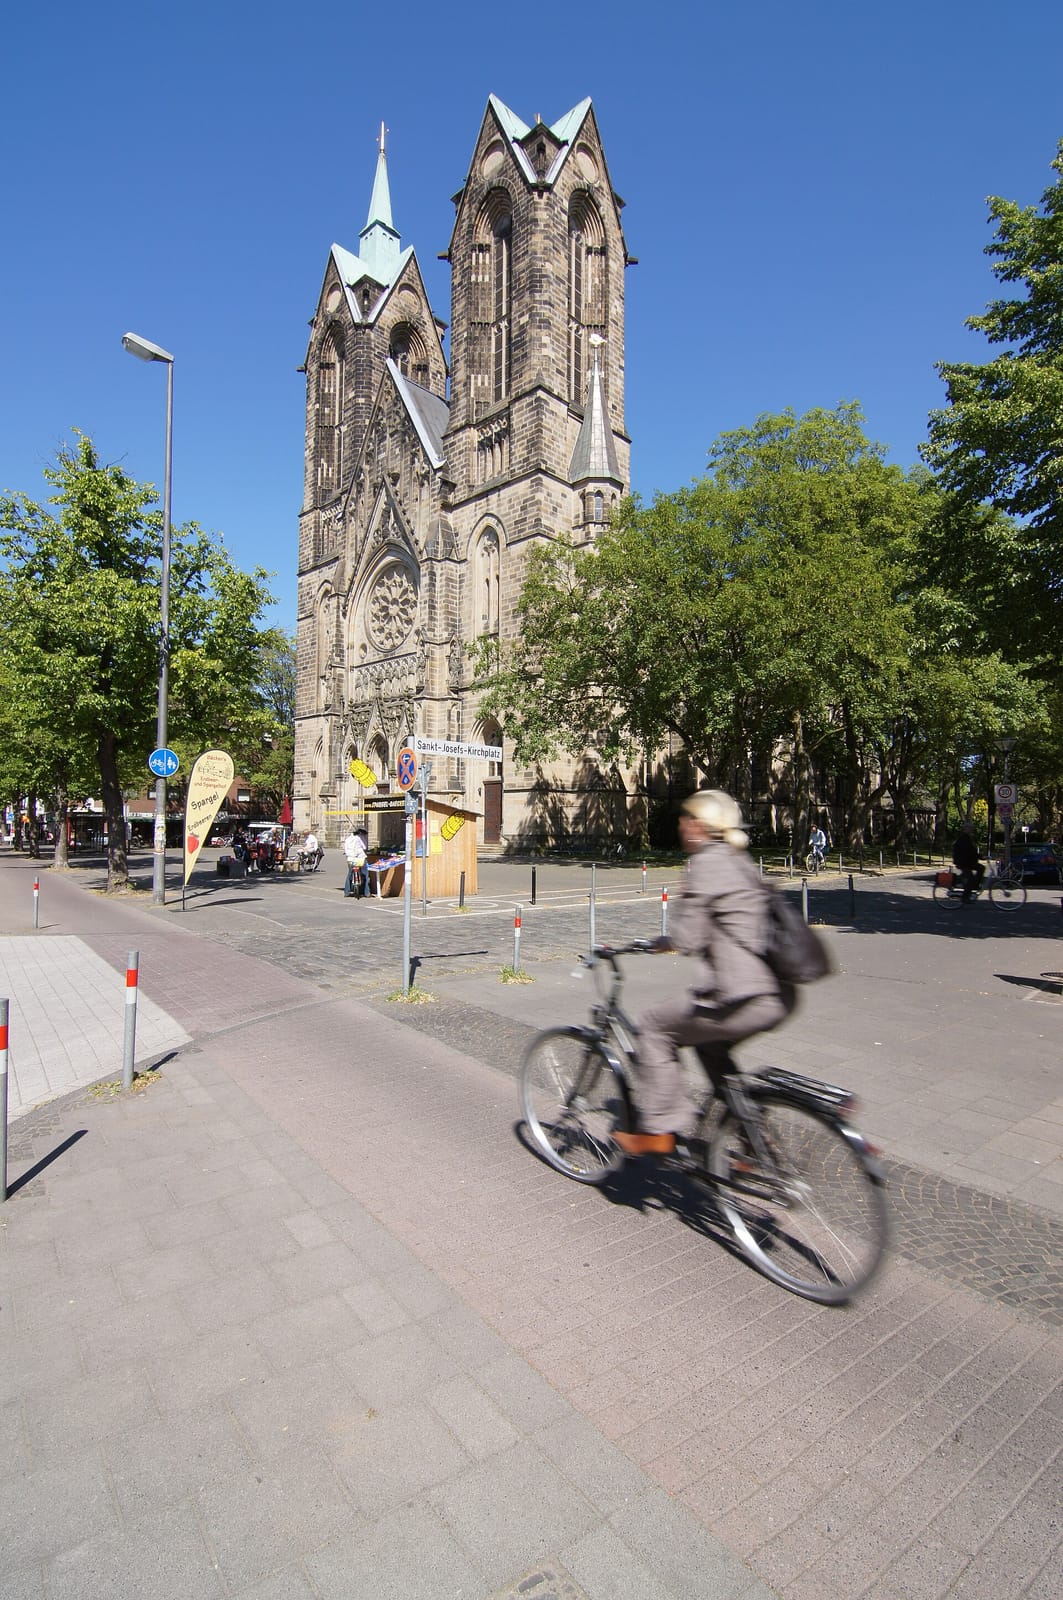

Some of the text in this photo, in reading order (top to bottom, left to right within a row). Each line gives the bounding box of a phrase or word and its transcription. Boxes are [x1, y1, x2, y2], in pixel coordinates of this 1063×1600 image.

[417, 740, 500, 758] Sankt-Josefs-Kirchplatz
[191, 791, 219, 811] Spargel
[187, 814, 212, 832] Erdbeeren
